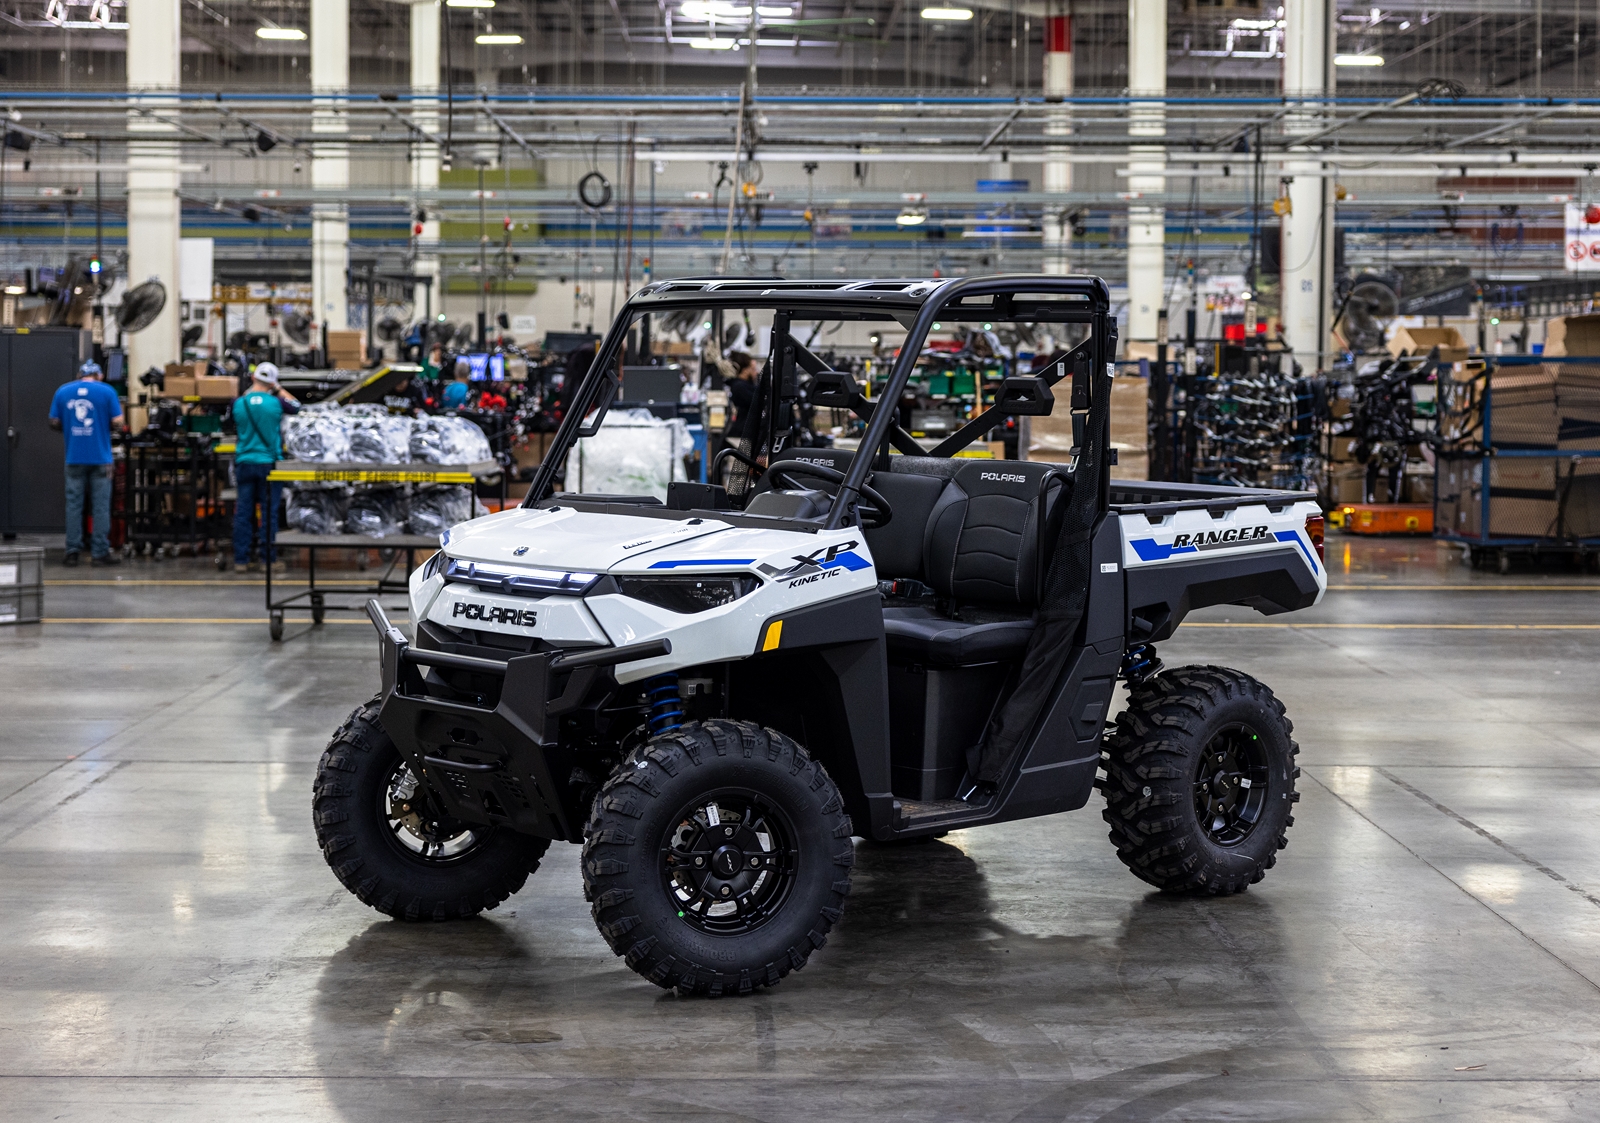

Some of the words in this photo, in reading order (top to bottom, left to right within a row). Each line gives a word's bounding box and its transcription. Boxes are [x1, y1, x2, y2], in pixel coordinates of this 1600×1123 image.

[980, 472, 1026, 483] POLARIS
[1172, 525, 1268, 548] RANGER
[786, 540, 860, 574] XP
[788, 568, 841, 589] KINETIC
[453, 602, 537, 627] POLARIS
